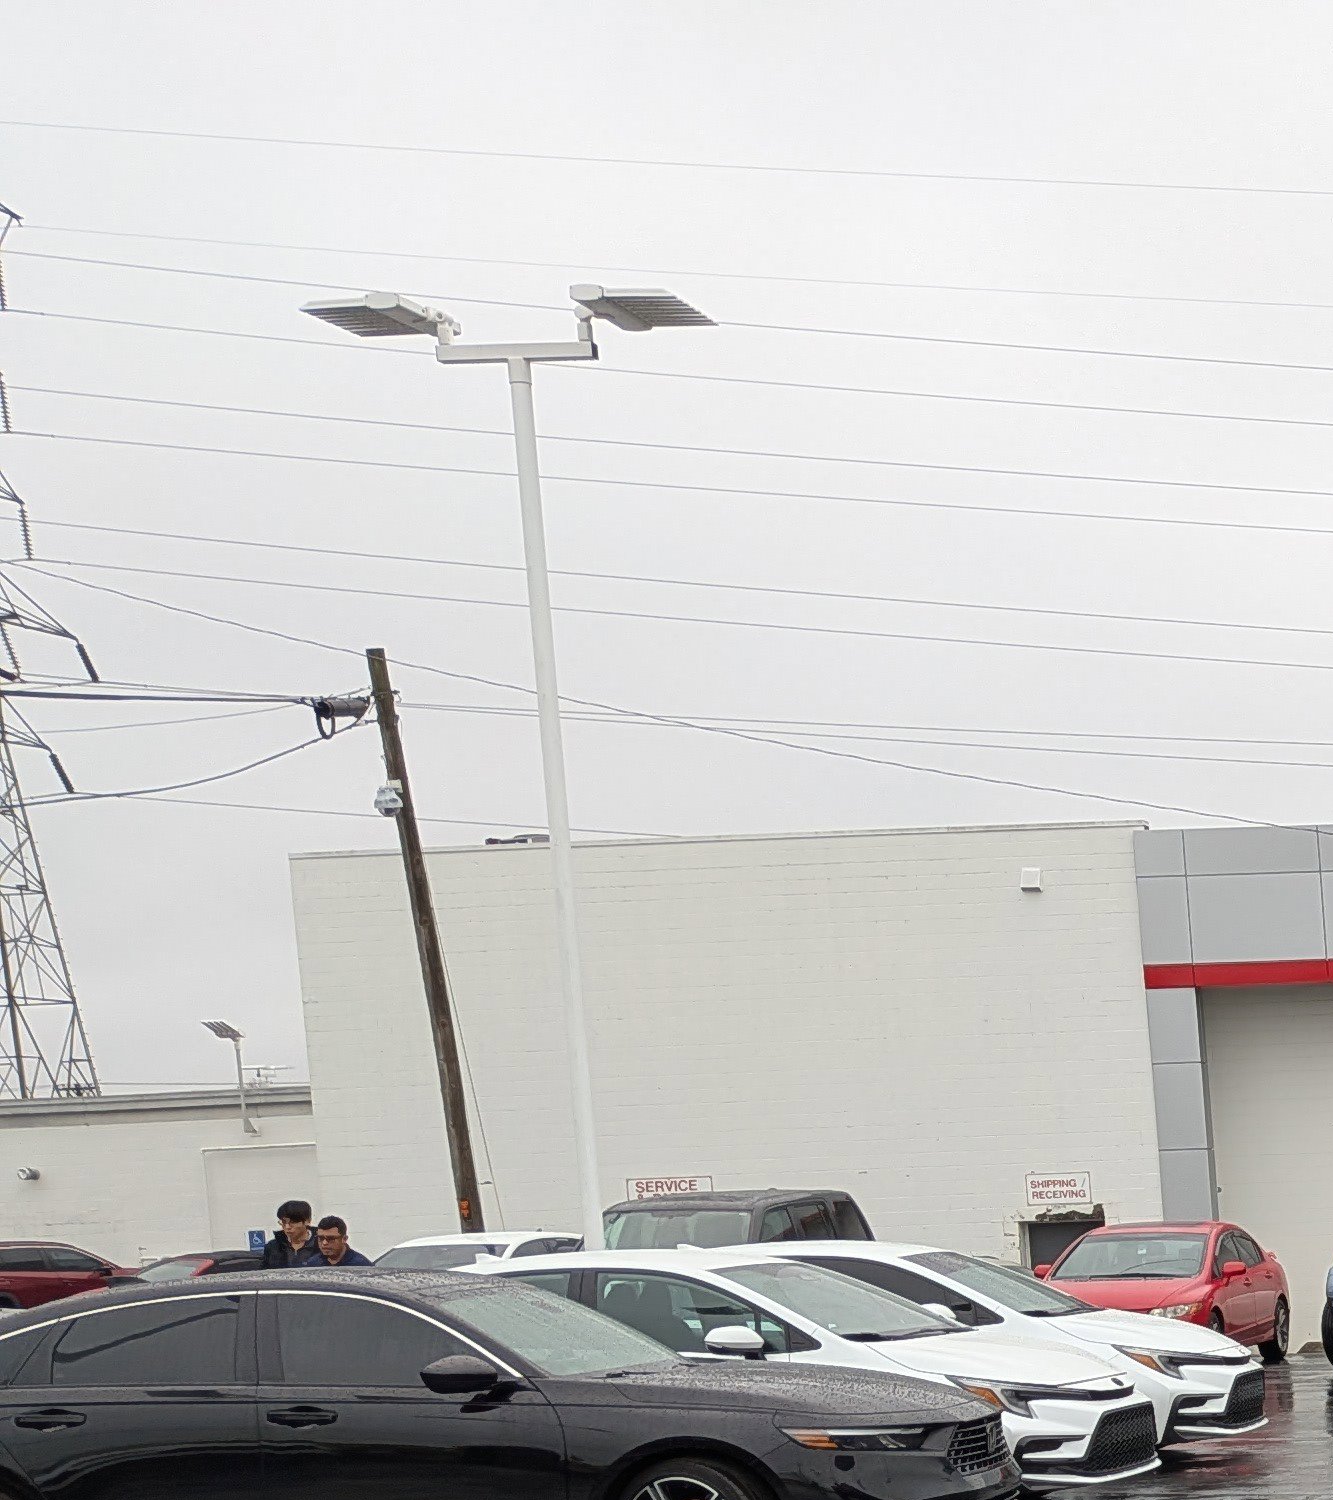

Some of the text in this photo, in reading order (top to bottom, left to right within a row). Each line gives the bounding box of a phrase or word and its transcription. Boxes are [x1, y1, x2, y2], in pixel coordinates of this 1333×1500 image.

[635, 1179, 698, 1193] SERVICE
[1030, 1179, 1077, 1189] SHIPPING
[1032, 1190, 1086, 1200] RECEIVING
